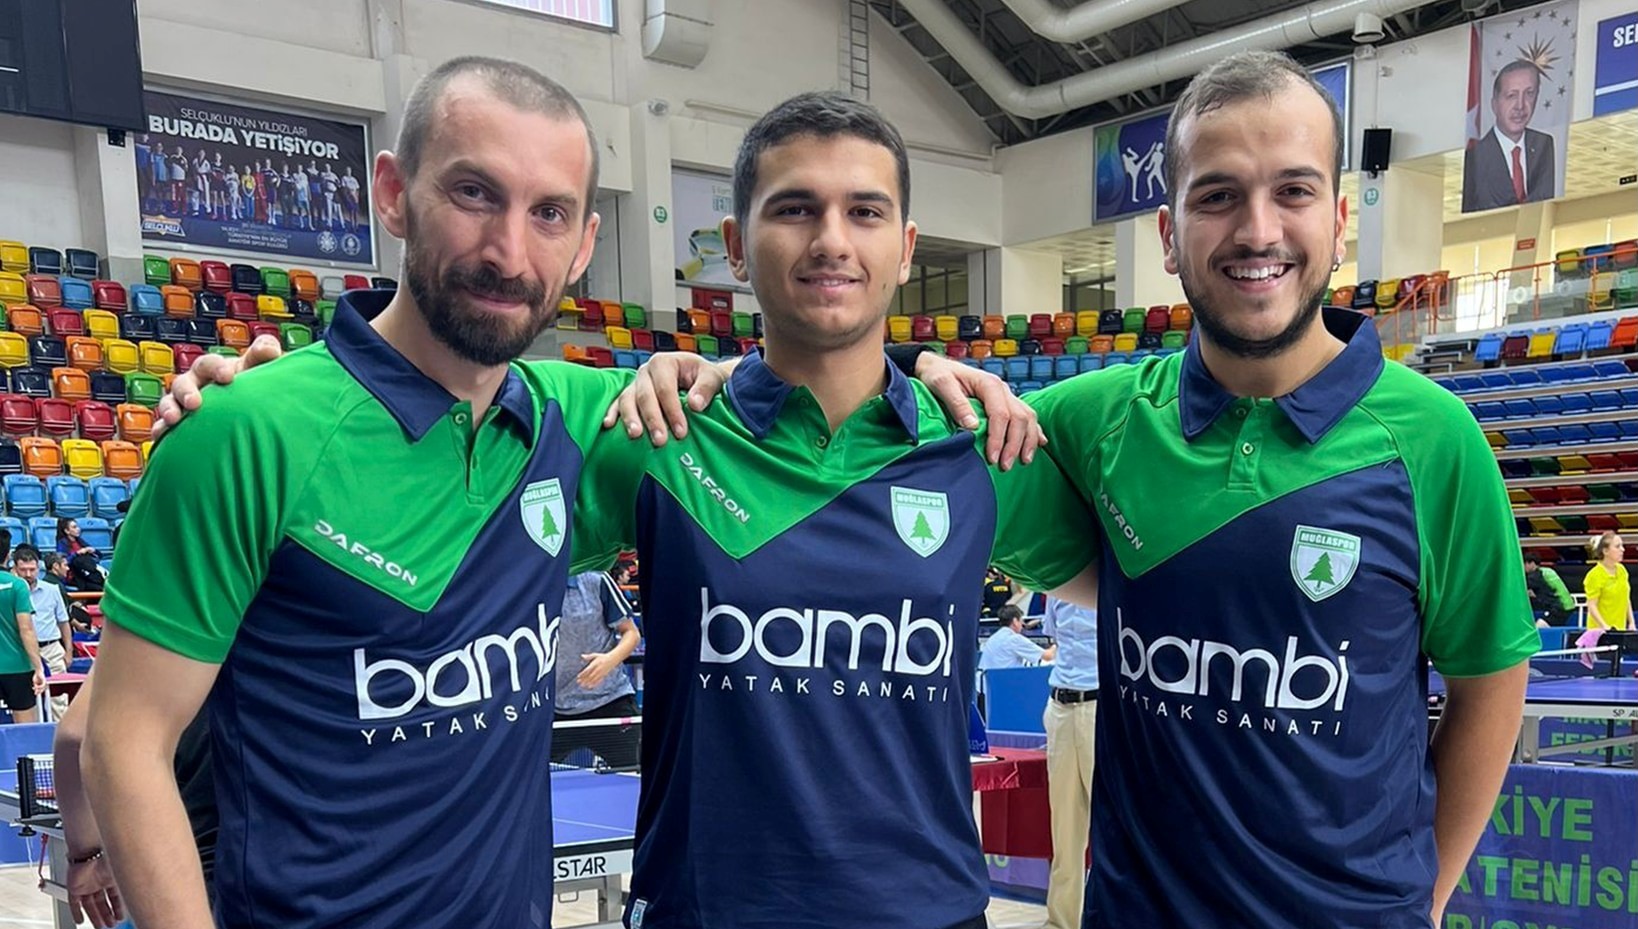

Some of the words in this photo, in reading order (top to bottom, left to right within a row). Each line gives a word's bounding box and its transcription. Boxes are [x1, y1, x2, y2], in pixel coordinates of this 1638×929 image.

[148, 114, 239, 146] BURADA
[239, 129, 340, 160] YETİŞİYOR
[180, 107, 257, 129] SELÇUKLU'NUN
[257, 120, 308, 136] YILDIZLARI
[680, 452, 750, 523] DAFRON
[314, 519, 418, 586] DAFRON
[700, 586, 955, 677] bambi
[1117, 606, 1350, 712] bambi
[698, 673, 810, 694] YATAK
[832, 680, 948, 702] SANATI
[361, 712, 487, 745] YATAK
[1216, 709, 1341, 736] SANATI
